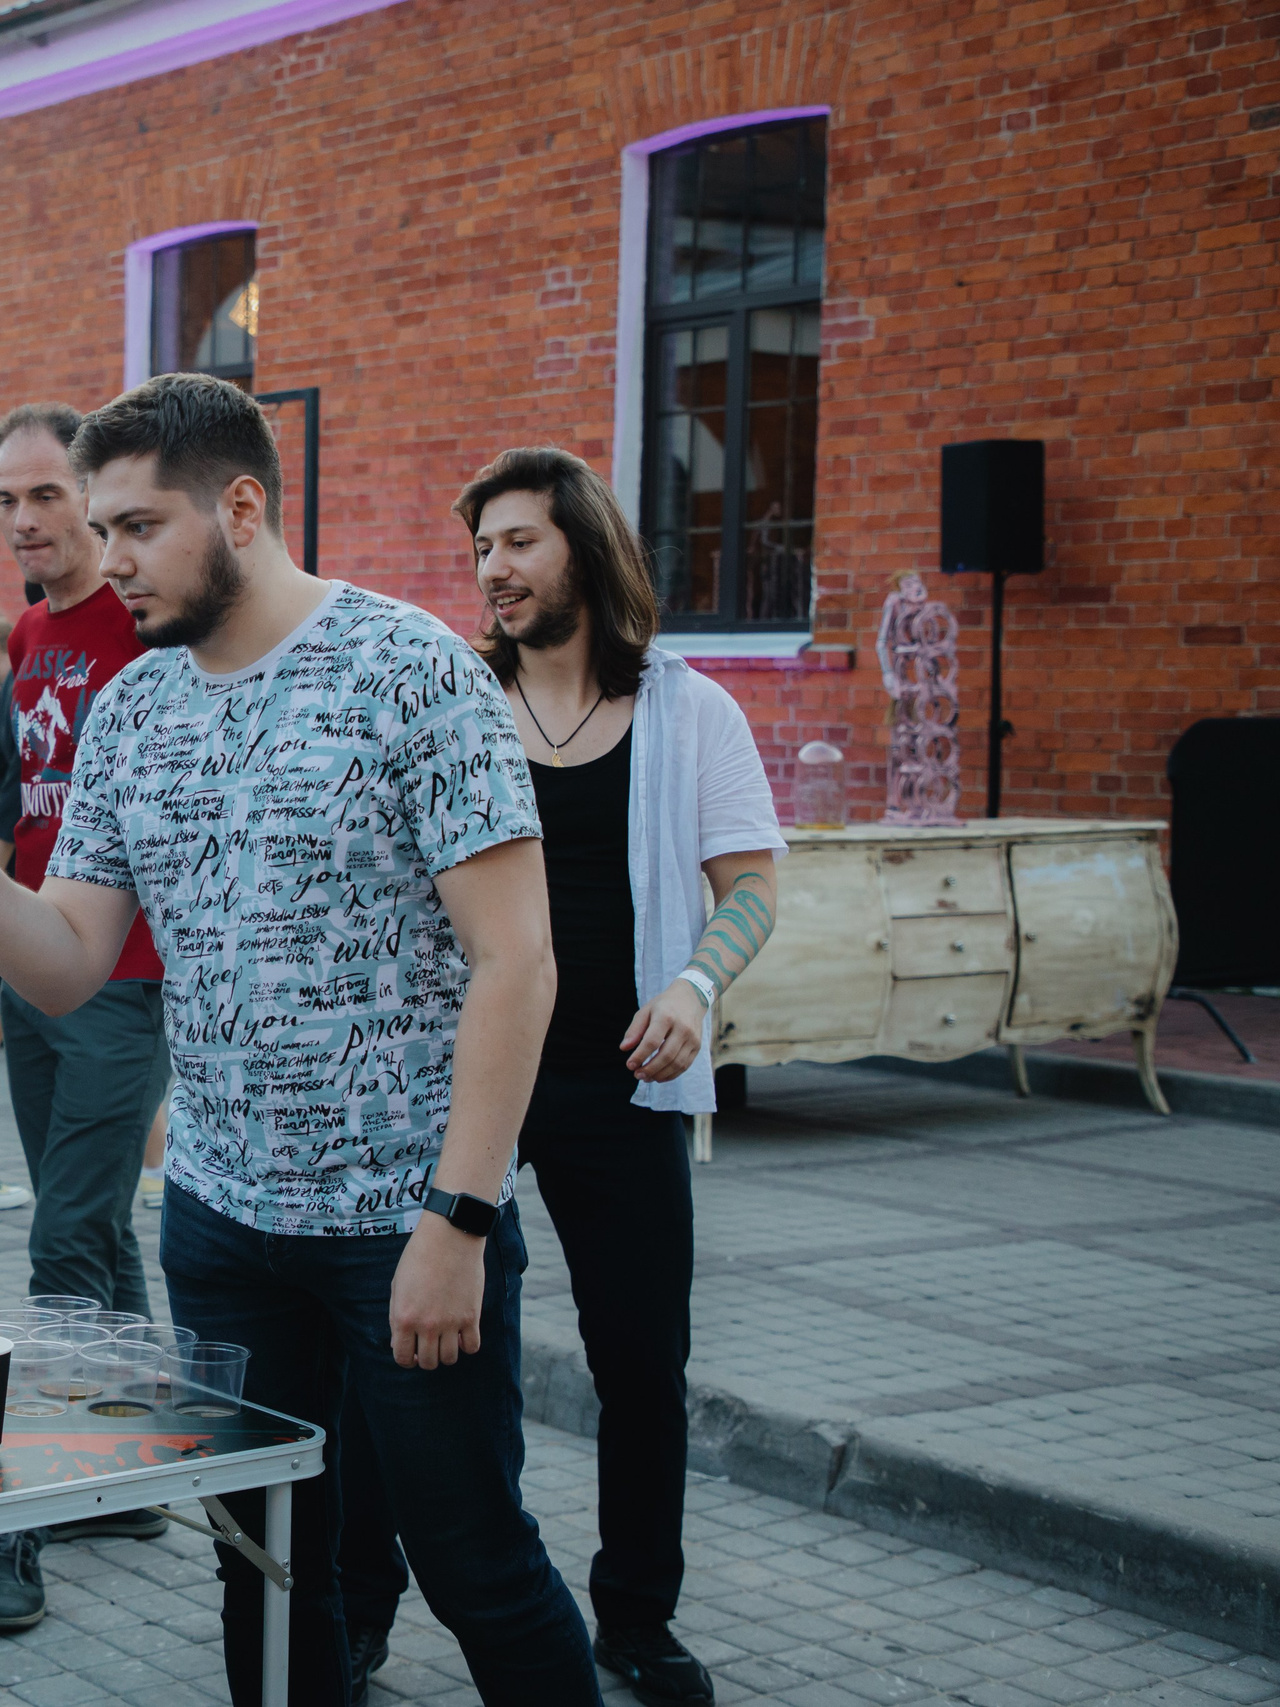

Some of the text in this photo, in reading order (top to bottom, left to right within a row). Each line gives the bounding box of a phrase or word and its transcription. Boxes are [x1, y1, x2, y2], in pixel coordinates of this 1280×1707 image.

[402, 653, 457, 725] wild
[215, 693, 277, 731] Keep
[222, 726, 243, 740] the
[200, 729, 268, 776] wild
[290, 871, 352, 903] you
[340, 881, 409, 918] Keep
[332, 914, 407, 964] wild
[351, 913, 377, 929] the
[285, 947, 314, 965] YOU
[190, 965, 243, 1004] Keep
[186, 1003, 244, 1045] wild
[240, 1014, 305, 1047] you.
[254, 1039, 280, 1057] YOU
[308, 1135, 369, 1167] you
[357, 1137, 431, 1169] Keep
[355, 1163, 434, 1213] wild
